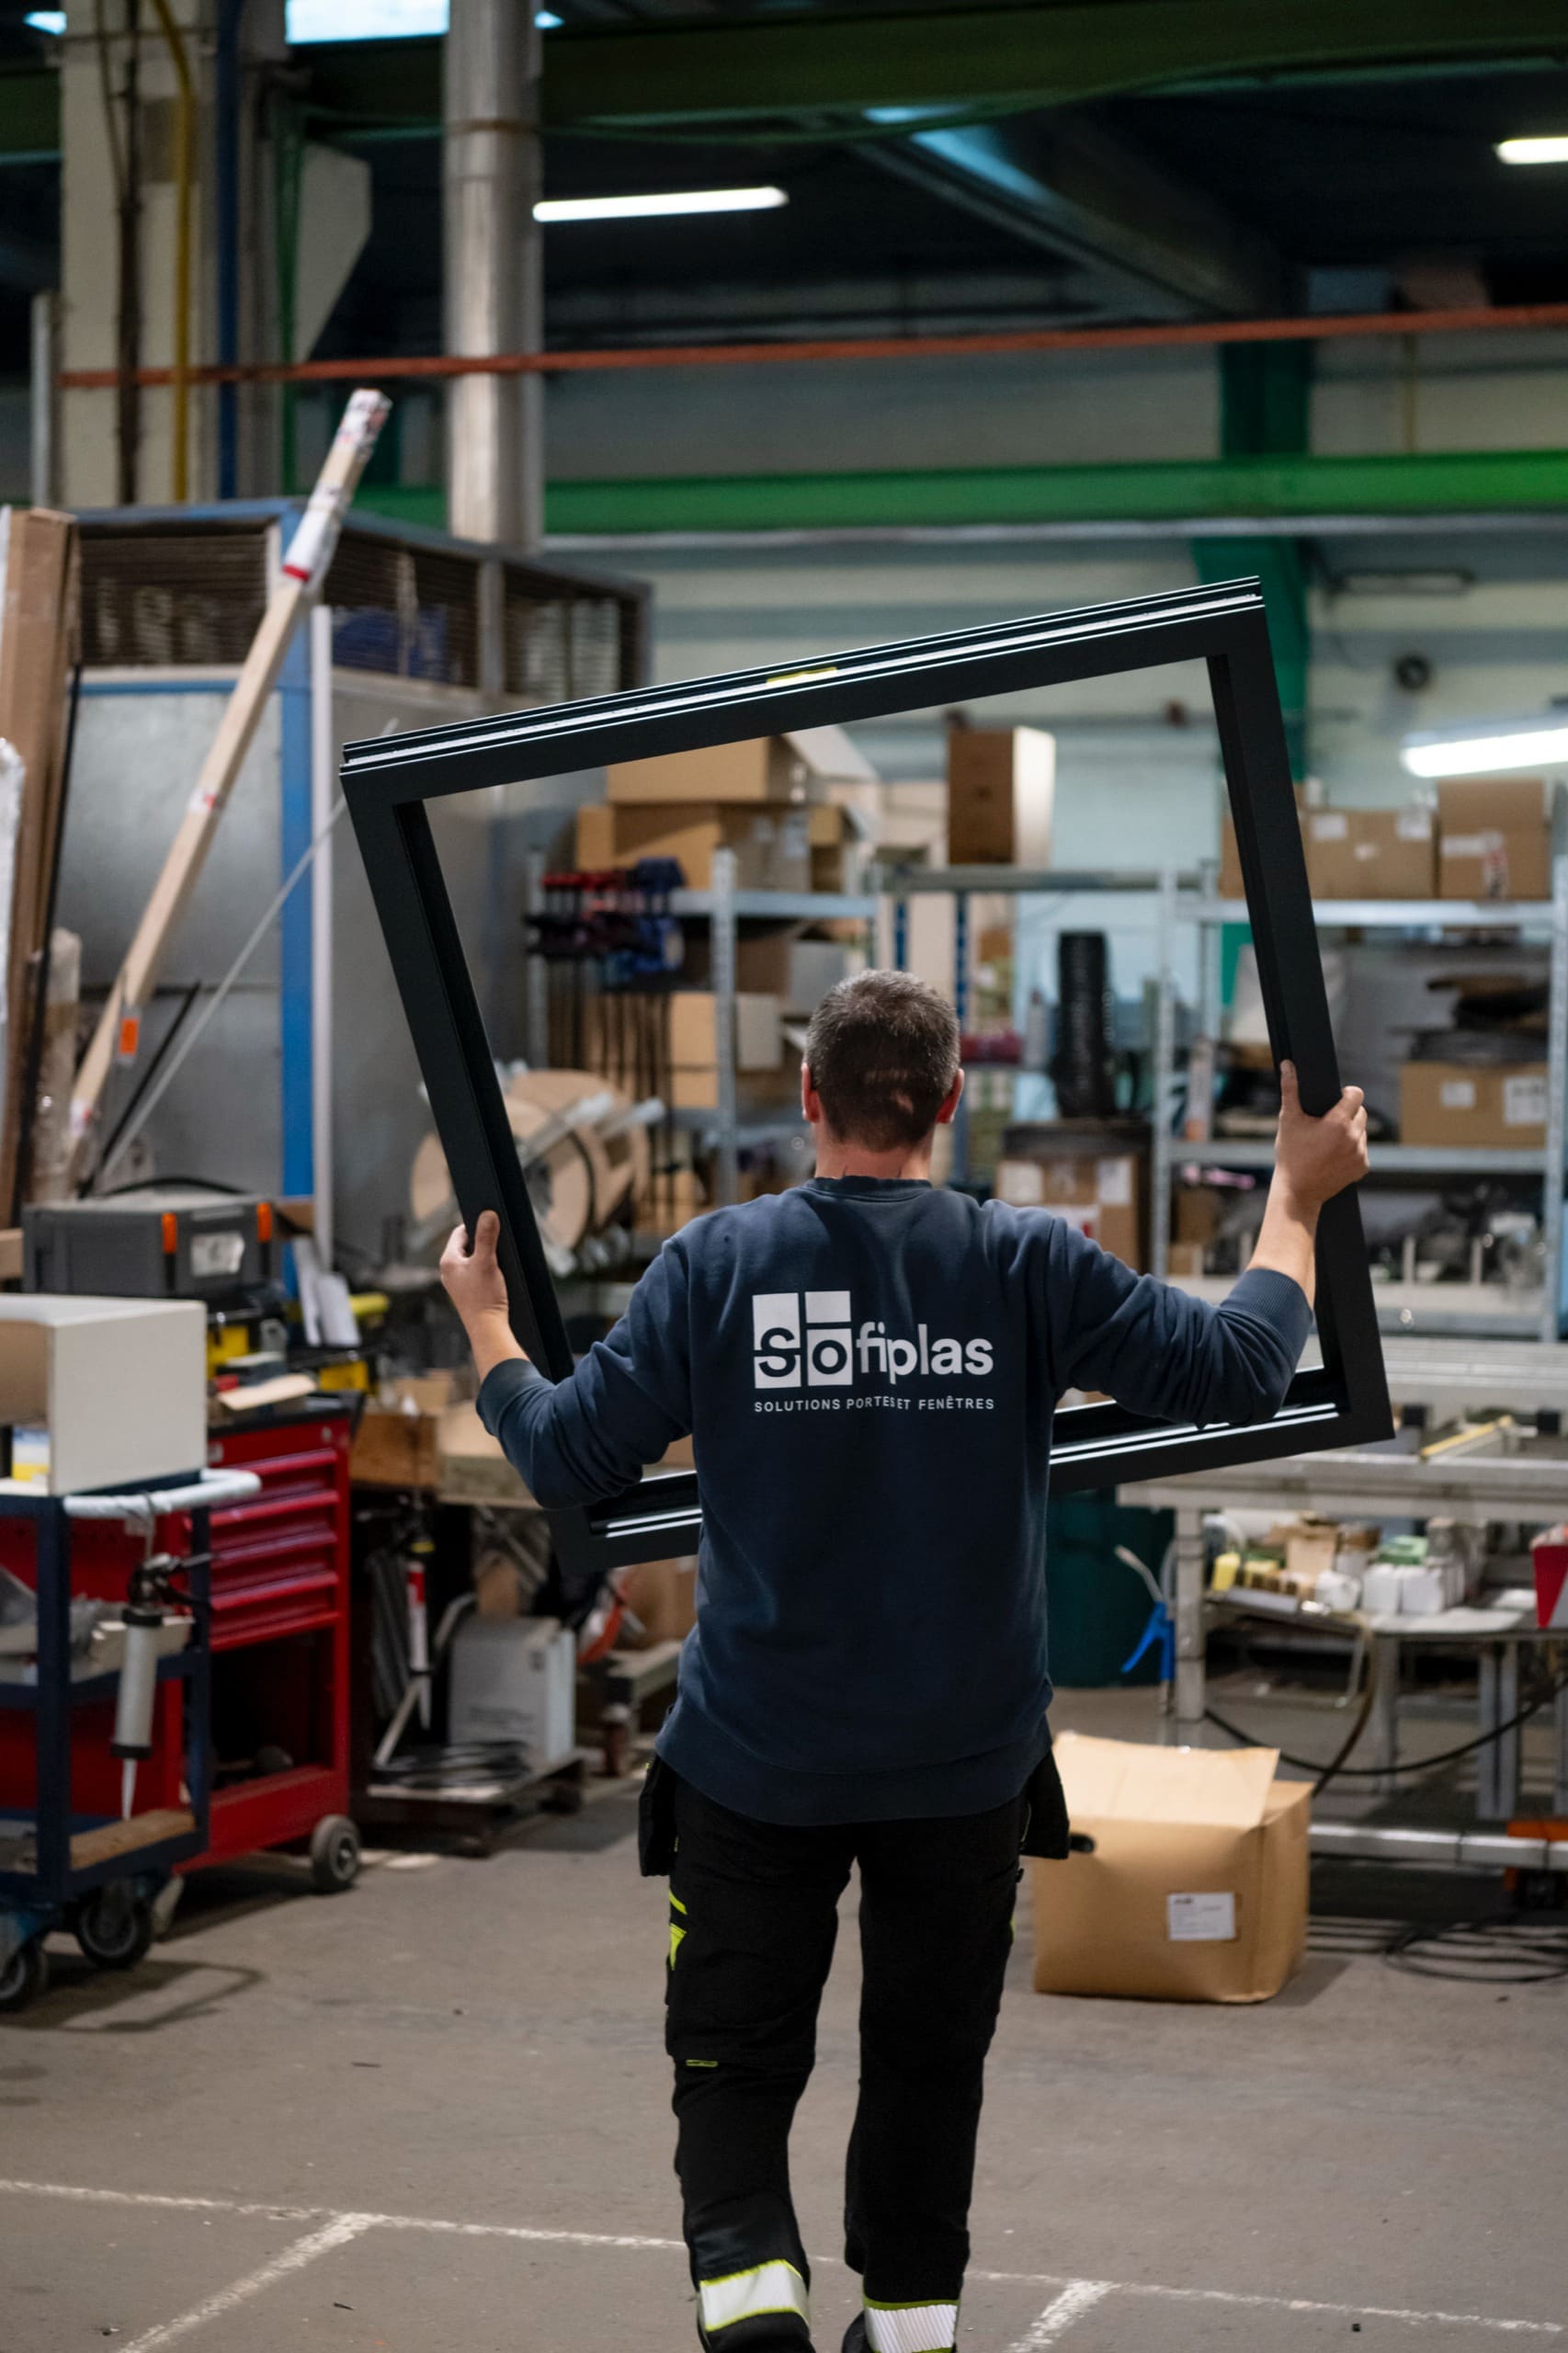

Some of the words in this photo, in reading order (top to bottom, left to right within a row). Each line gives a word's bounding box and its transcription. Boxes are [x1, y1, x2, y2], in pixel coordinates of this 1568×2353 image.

[757, 1321, 994, 1385] Sofiplas
[754, 1398, 841, 1413] SOLUTIONS
[846, 1395, 895, 1410] PORTES
[897, 1398, 911, 1410] ET
[918, 1395, 994, 1411] FENÊTRES
